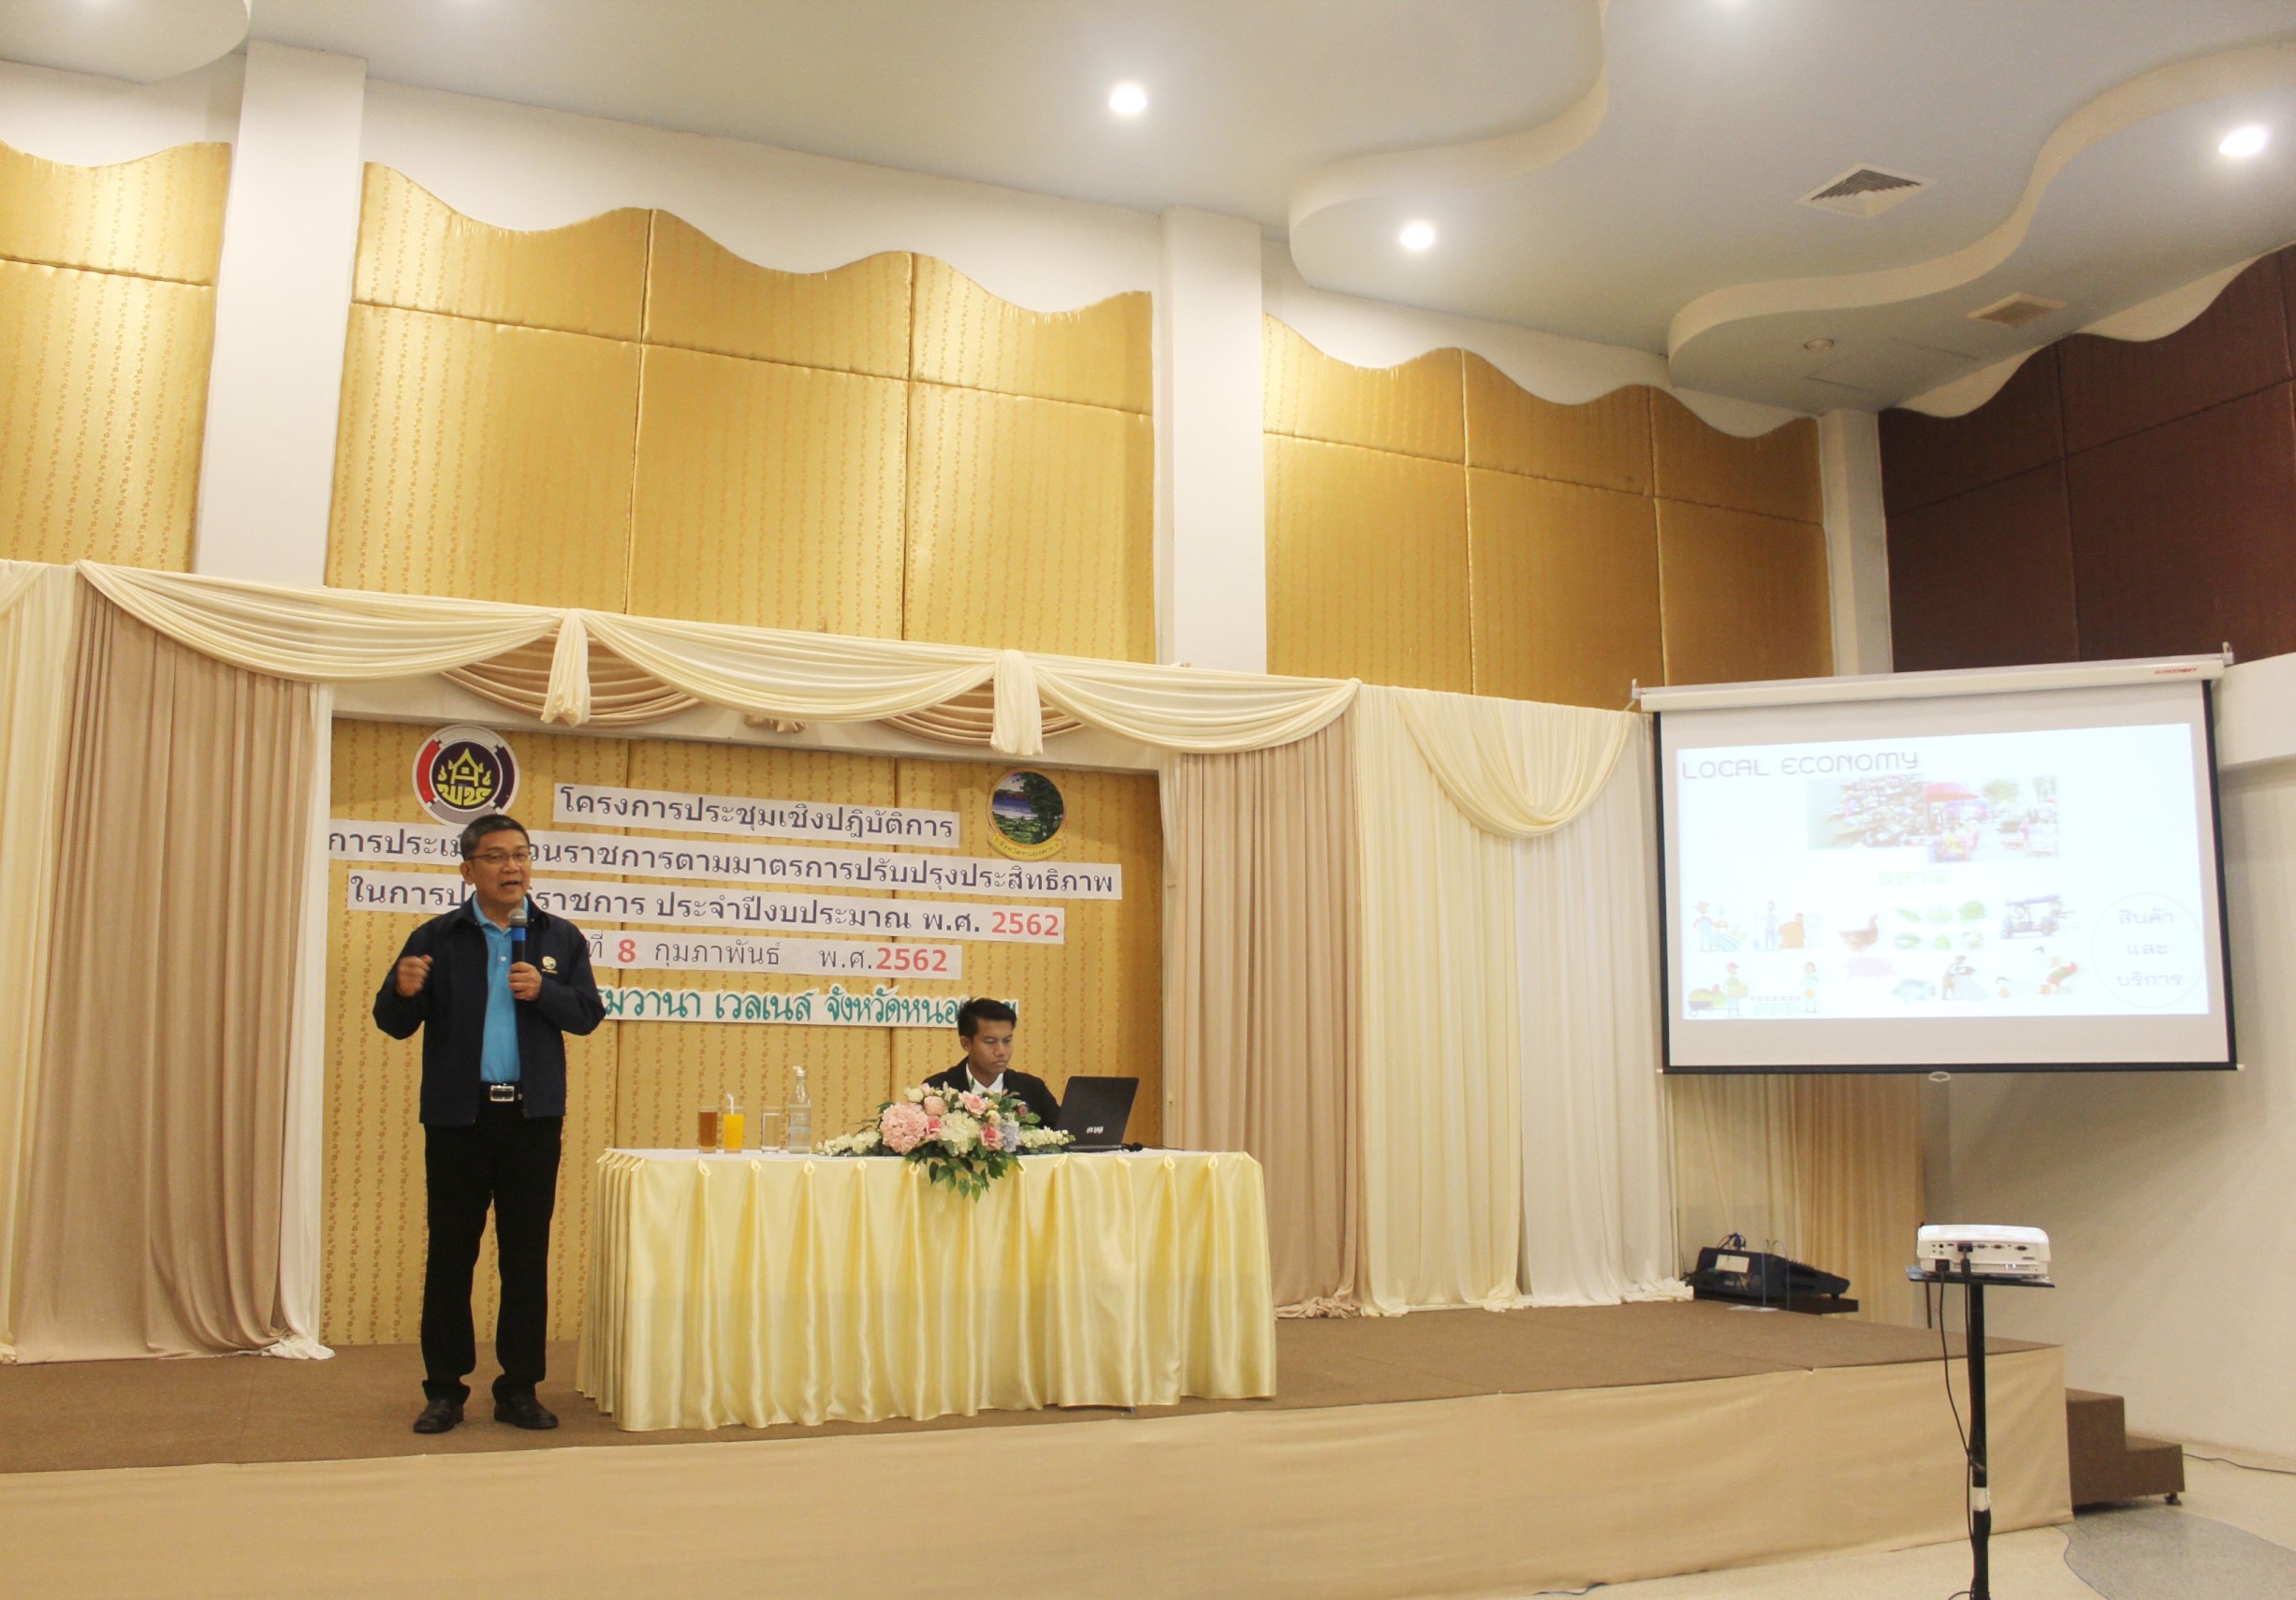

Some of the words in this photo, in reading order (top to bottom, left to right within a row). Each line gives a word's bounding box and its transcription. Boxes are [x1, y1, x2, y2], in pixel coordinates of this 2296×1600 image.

[1682, 759, 1770, 779] LOCAL
[1781, 752, 1918, 775] ECONOMY
[560, 786, 954, 838] โครงการประชุมเชิงปฏิบัติการ
[656, 891, 912, 930] ประจำปีงบประมาณ
[922, 913, 981, 932] พ.ศ.
[991, 912, 1060, 937] 2562
[617, 939, 636, 963] 8
[655, 939, 782, 968] กุมภาพันธ์
[2127, 944, 2169, 956] และ
